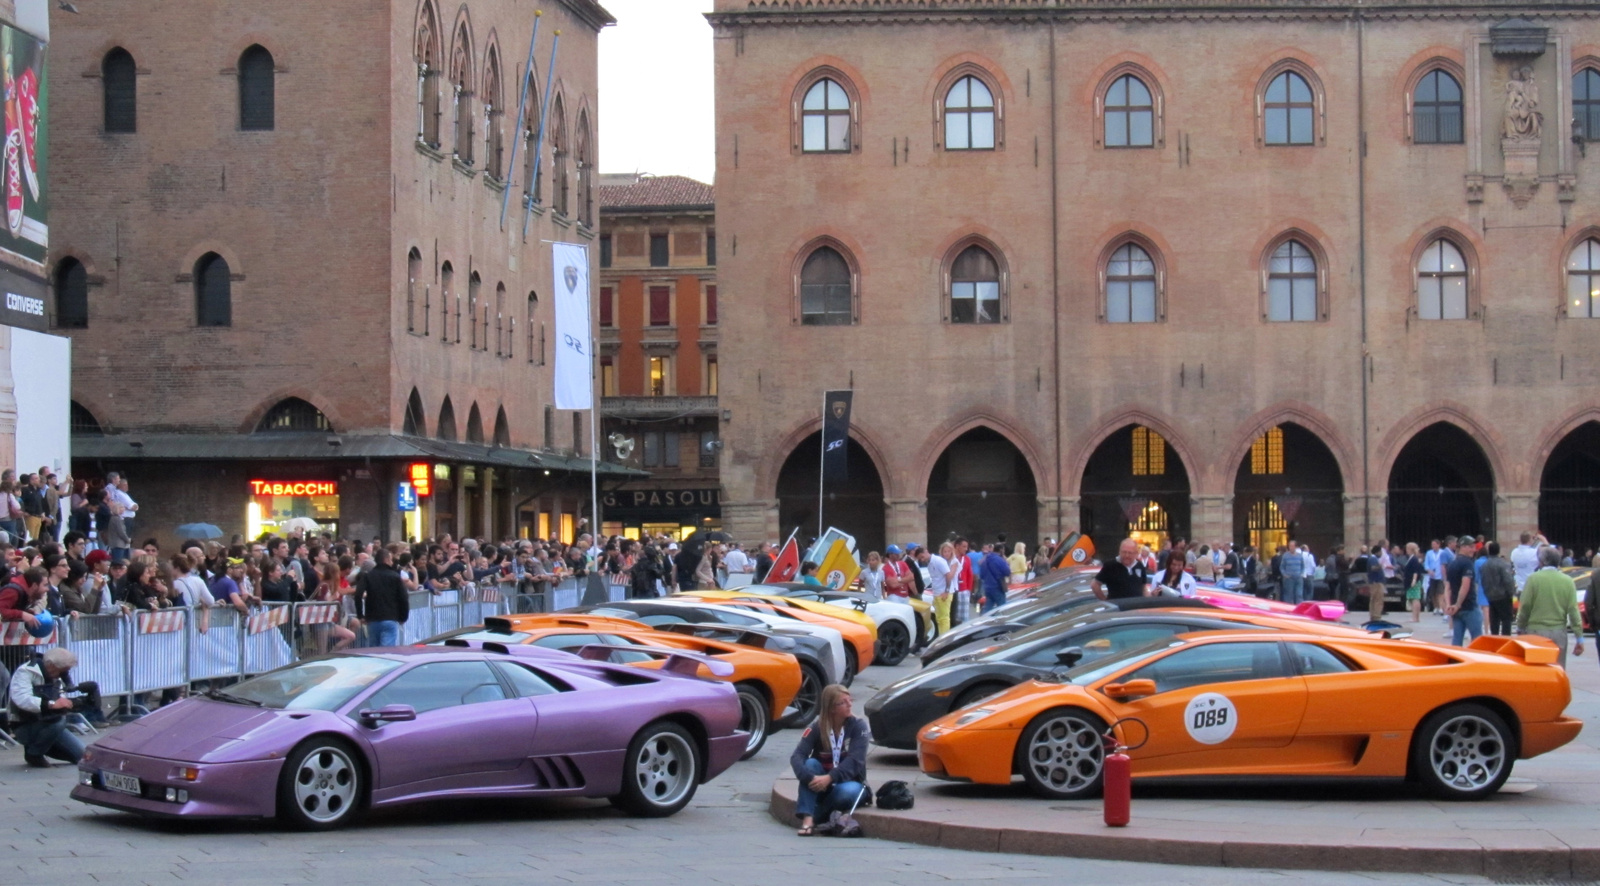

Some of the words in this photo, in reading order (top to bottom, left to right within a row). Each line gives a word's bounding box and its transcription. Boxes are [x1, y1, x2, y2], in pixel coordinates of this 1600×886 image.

[6, 292, 44, 316] CONVERSE
[251, 480, 334, 495] TABACCHI
[603, 492, 622, 506] G.
[1194, 707, 1228, 729] 089
